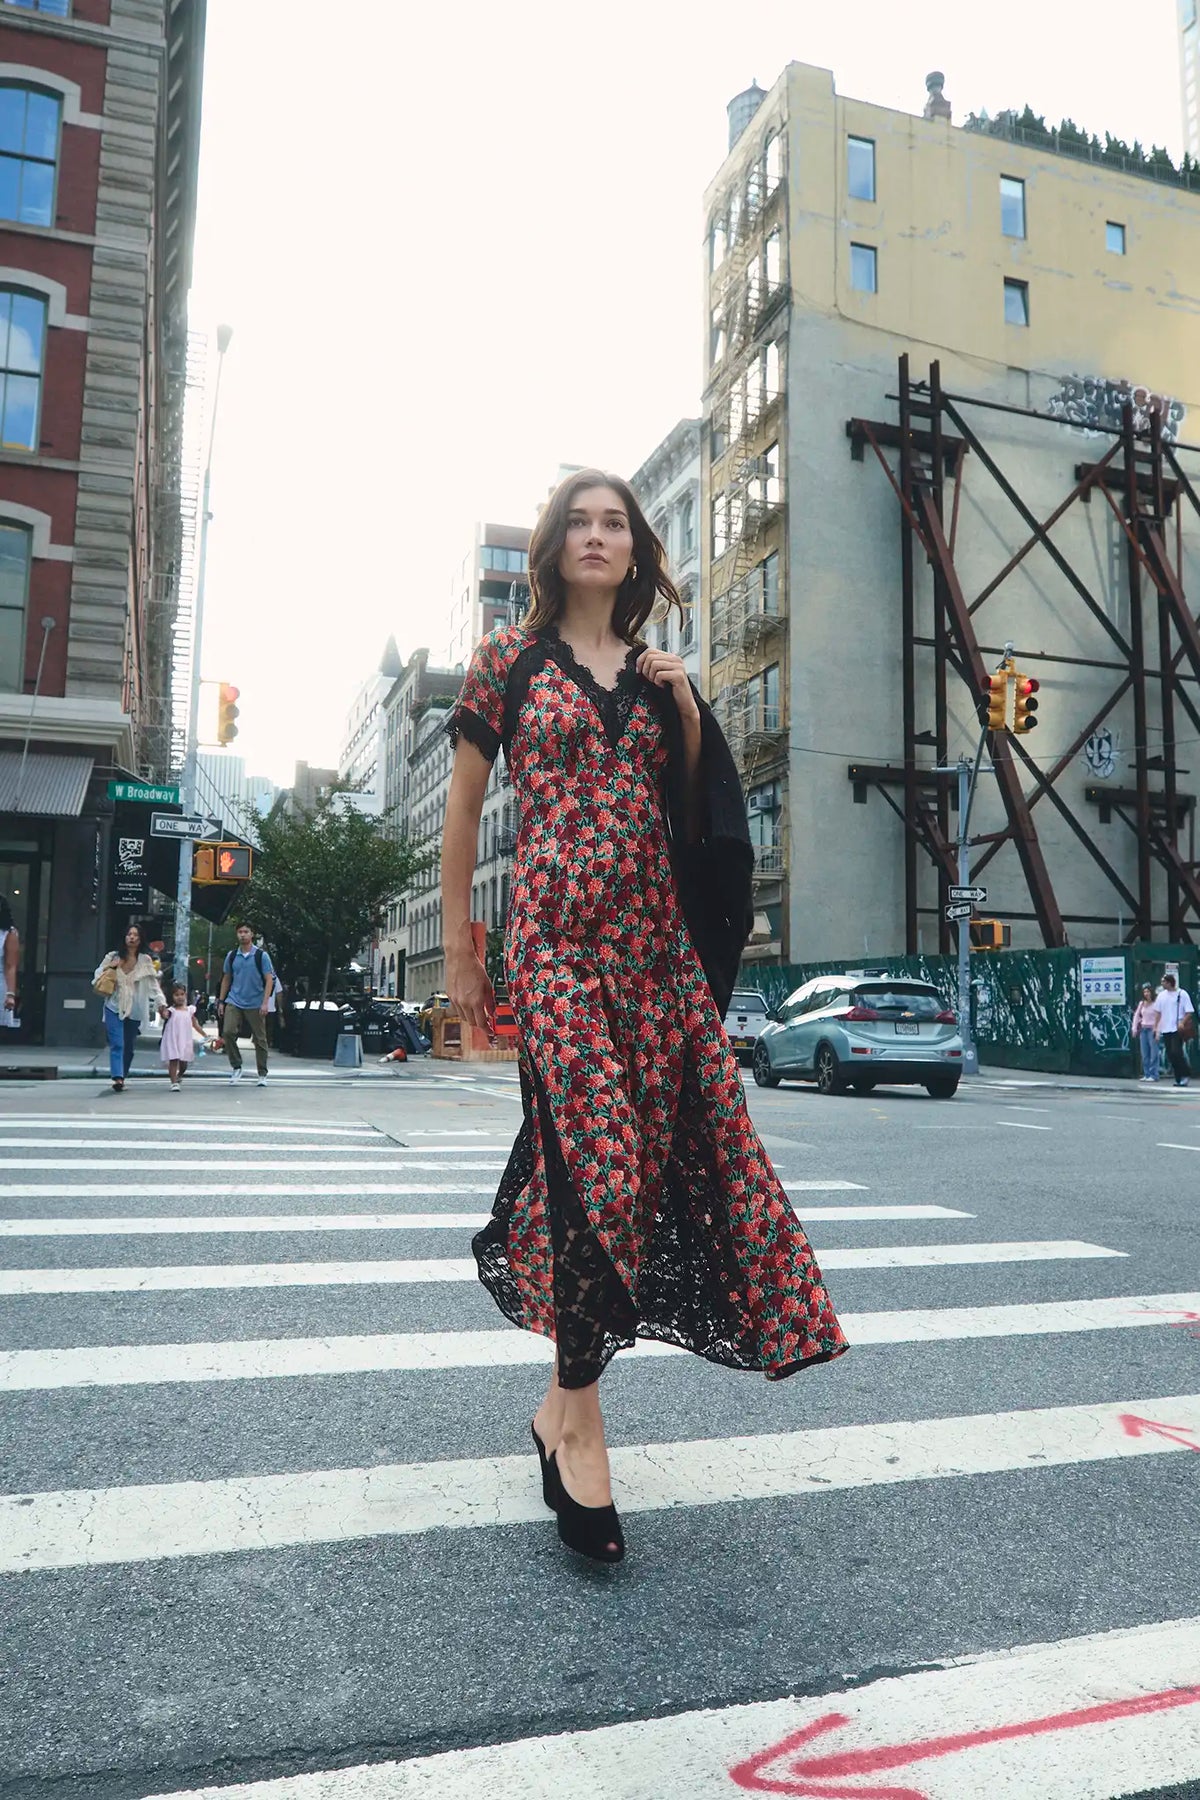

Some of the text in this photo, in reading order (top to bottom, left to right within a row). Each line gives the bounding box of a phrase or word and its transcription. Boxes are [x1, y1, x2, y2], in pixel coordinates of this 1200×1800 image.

[115, 785, 175, 803] W Broadway
[159, 820, 209, 833] ONE WAY
